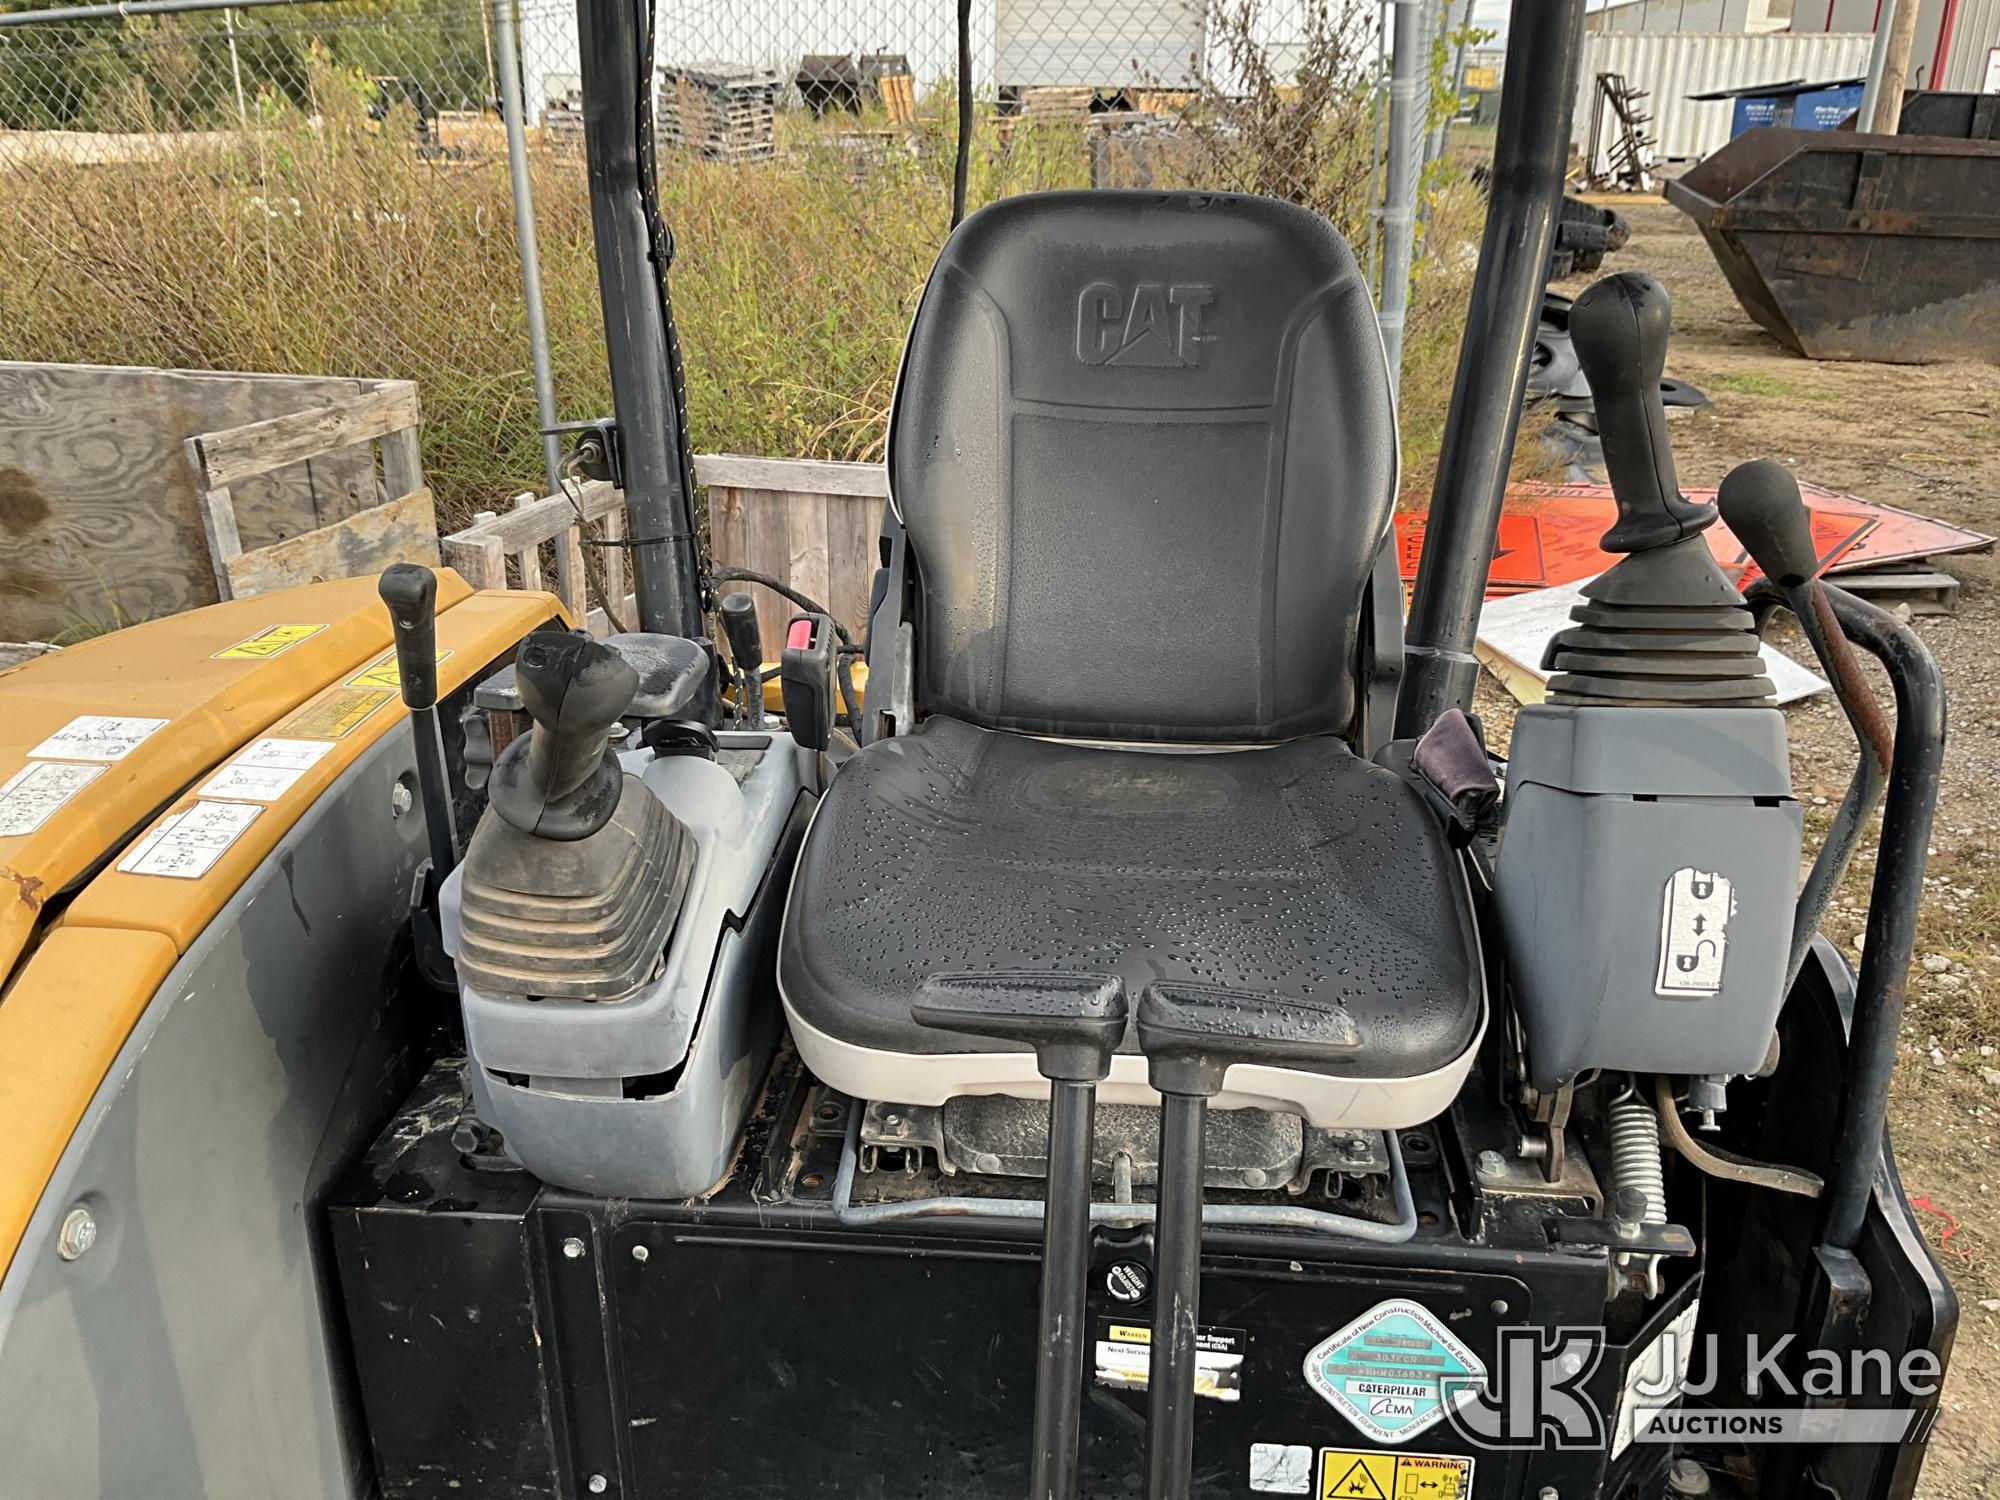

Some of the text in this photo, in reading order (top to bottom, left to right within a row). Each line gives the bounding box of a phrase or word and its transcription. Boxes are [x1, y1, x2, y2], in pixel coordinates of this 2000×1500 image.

[1077, 281, 1217, 368] CAT
[1118, 1272, 1136, 1292] ADJUST
[1123, 1265, 1146, 1290] WEIGHT
[1206, 1334, 1236, 1346] Support
[1317, 1332, 1353, 1360] Certificate
[1357, 1320, 1375, 1333] New
[1373, 1306, 1424, 1322] Construction
[1422, 1319, 1448, 1345] Machine
[1446, 1341, 1457, 1352] for
[1454, 1349, 1477, 1372] Export
[1107, 1345, 1124, 1354] Next
[1358, 1383, 1427, 1397] CATERPILLAR
[1311, 1363, 1322, 1384] JAPAN
[1320, 1381, 1360, 1418] CONSTRUCTION
[1358, 1412, 1395, 1439] EQUIPMENT
[1370, 1398, 1414, 1416] CEMA
[1414, 1459, 1467, 1470] WARNING
